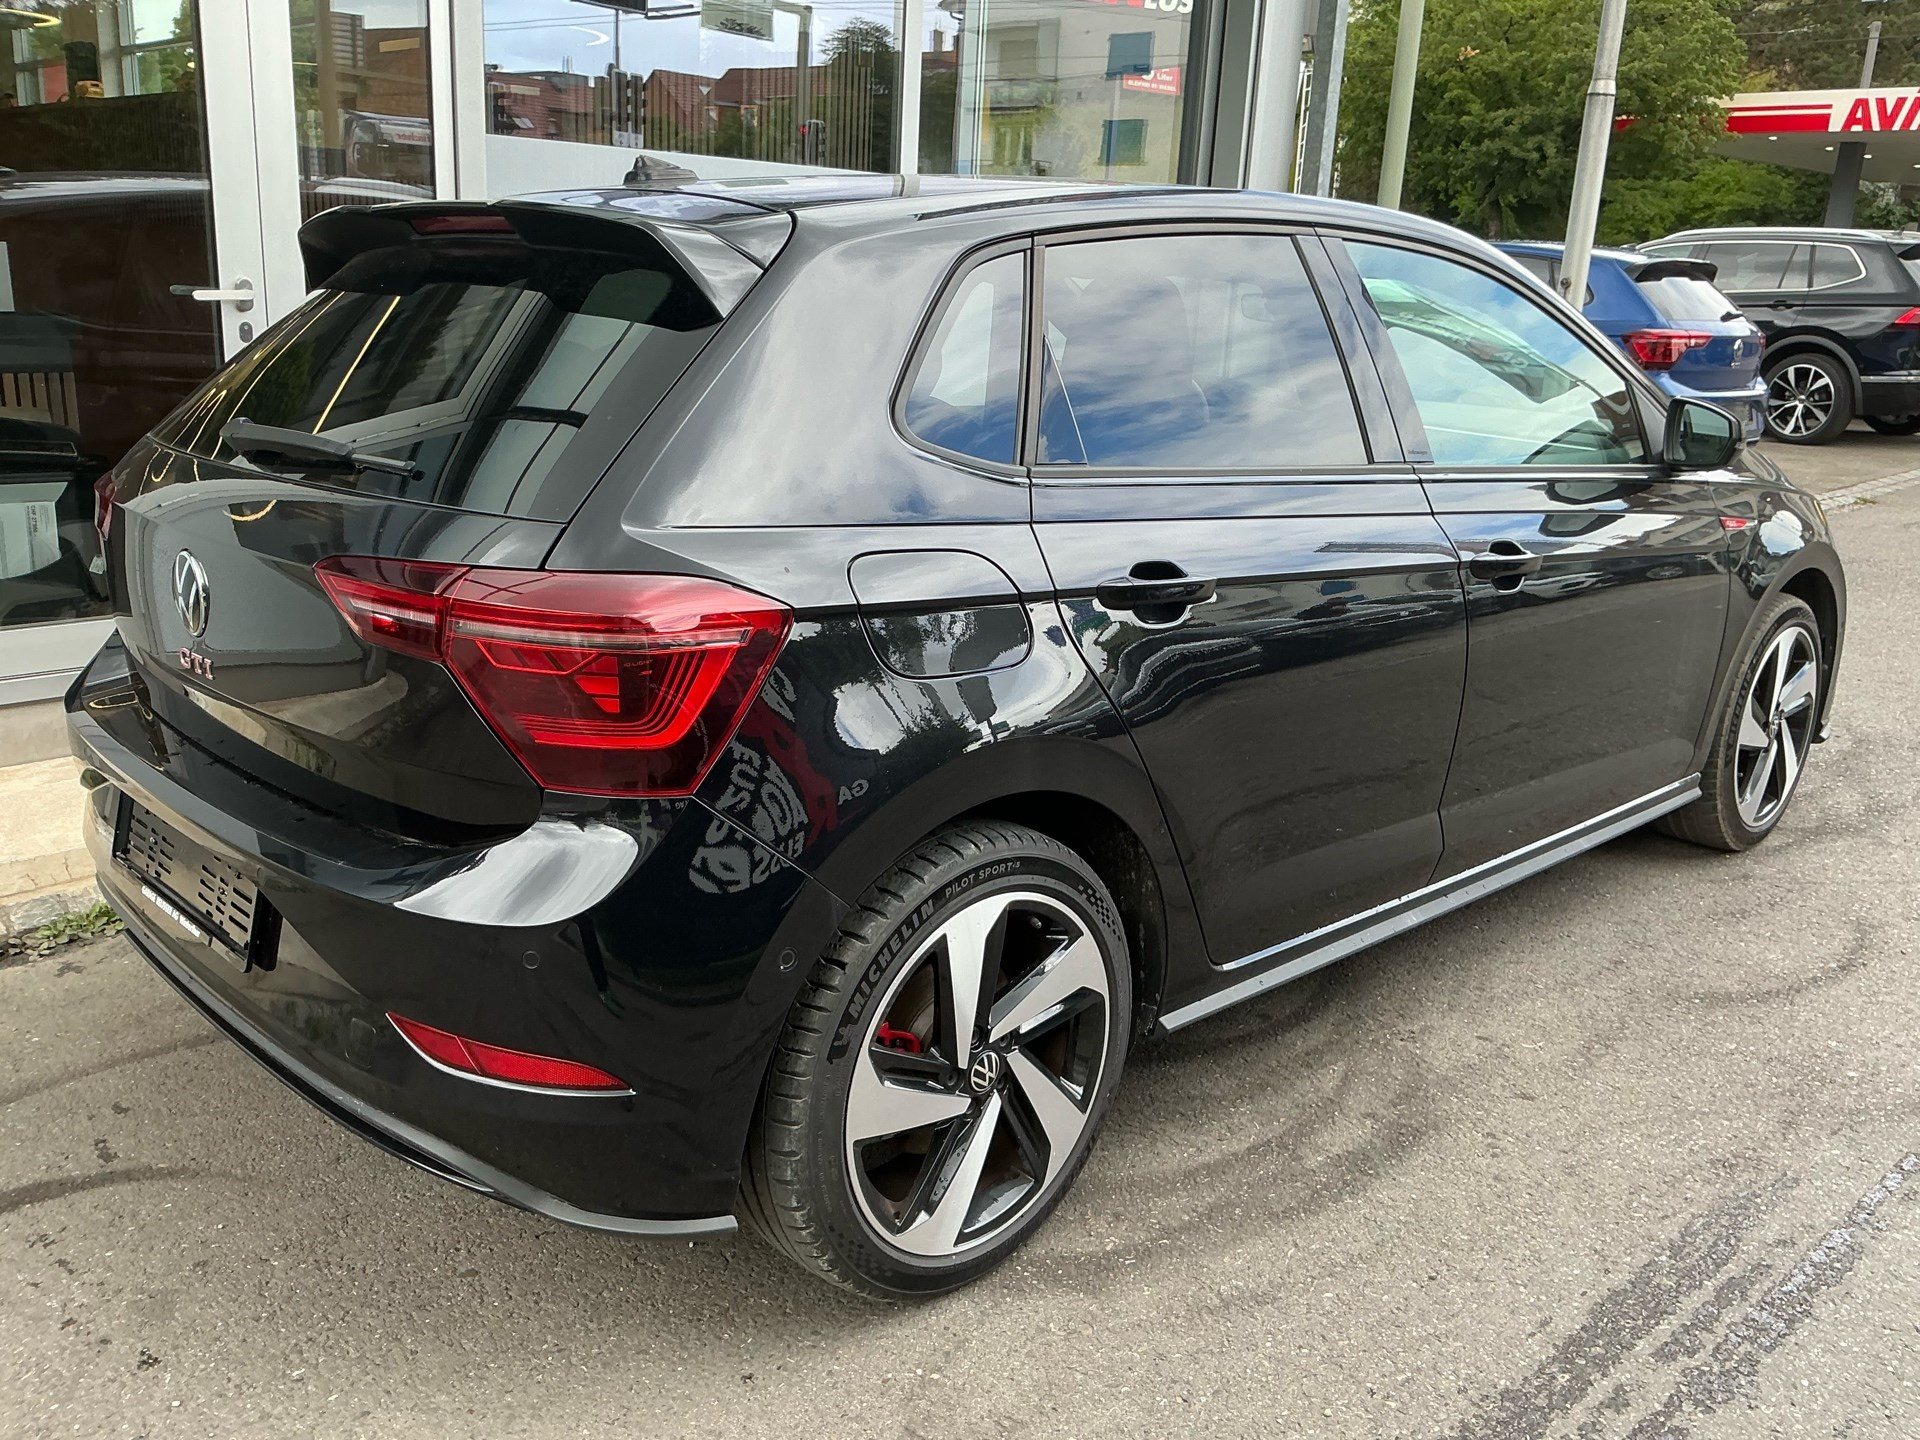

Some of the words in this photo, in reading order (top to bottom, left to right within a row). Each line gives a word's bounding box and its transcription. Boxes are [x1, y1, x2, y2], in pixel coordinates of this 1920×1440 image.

[1841, 97, 1920, 131] AVI
[179, 647, 214, 681] GTI
[848, 899, 935, 1019] MICHELIN
[945, 873, 975, 898] PILOT
[979, 862, 1013, 879] SPORT
